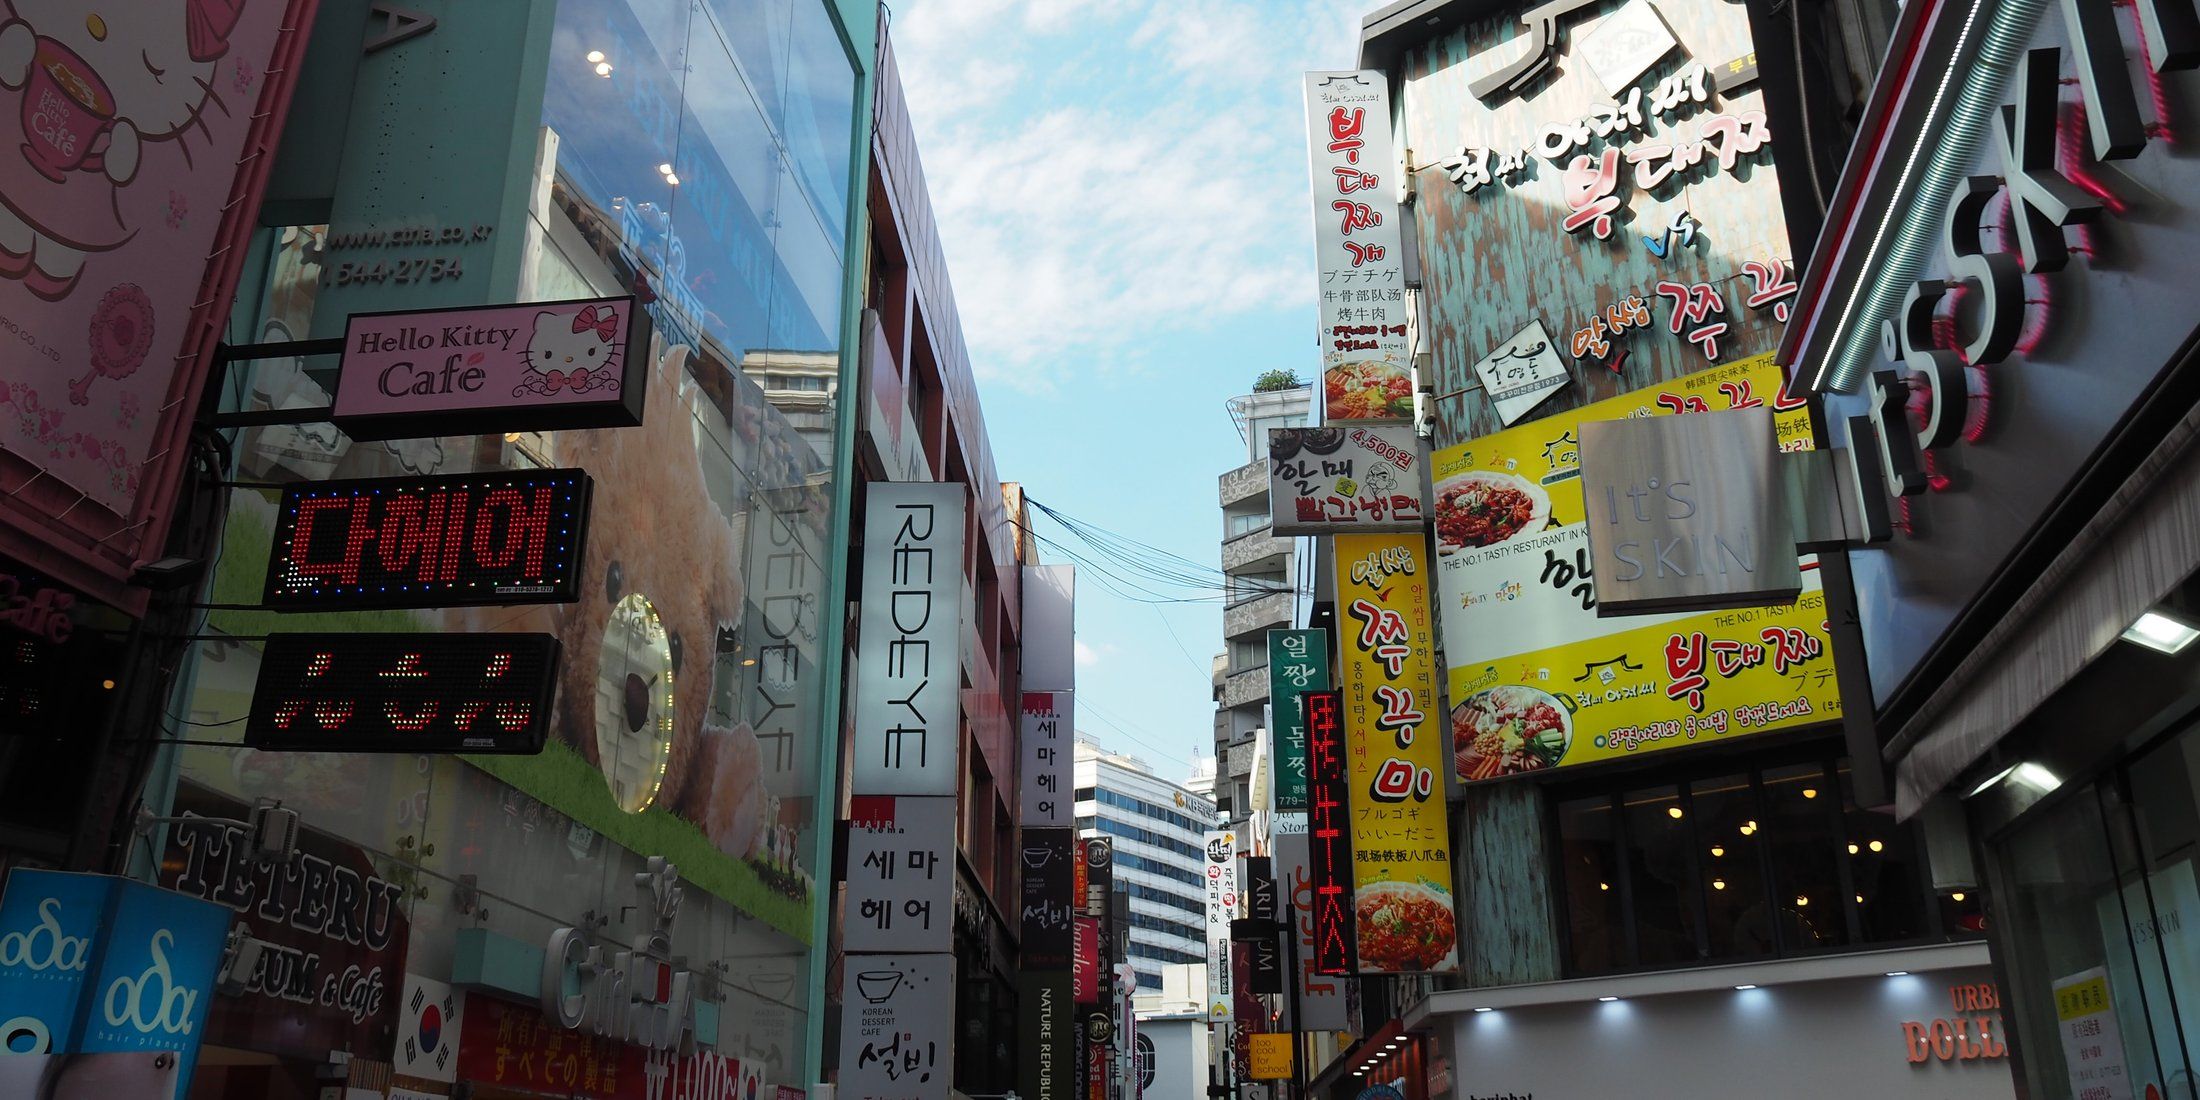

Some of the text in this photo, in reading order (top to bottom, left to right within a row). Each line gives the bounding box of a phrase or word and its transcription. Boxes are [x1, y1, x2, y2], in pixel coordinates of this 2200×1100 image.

[1327, 106, 1386, 267] 부대찌개
[1561, 110, 1773, 241] 부대찌
[1323, 268, 1399, 284] ブデチゲ
[1323, 289, 1401, 303] 牛骨部队汤
[1337, 307, 1386, 322] 烤牛肉
[1656, 257, 1797, 362] 쭈꾸
[357, 325, 518, 354] Hello Kitty
[1776, 417, 1810, 437] 场铁
[1350, 428, 1415, 473] 4,500원
[1295, 495, 1422, 523] 빨간냉면
[1443, 559, 1461, 571] THE
[1462, 555, 1482, 566] NO.1
[1483, 546, 1511, 561] TASTY
[1513, 532, 1567, 554] RESTURANT
[1569, 530, 1579, 540] IN
[1614, 526, 1754, 582] SKIN
[1714, 614, 1735, 628] THE
[1737, 610, 1761, 622] NO.1
[1765, 604, 1796, 618] TASTY
[884, 504, 934, 770] REDEYE
[1664, 620, 1831, 712] 부대찌
[1790, 668, 1834, 692] ブデ
[1608, 718, 1682, 751] 라면사리와
[1684, 706, 1729, 739] 공기밥
[1354, 728, 1368, 773] 서비스
[1279, 796, 1307, 807] 779-
[1357, 807, 1421, 821] ブルゴギ
[851, 820, 895, 829] HAIR
[1279, 821, 1308, 834] Stor
[863, 850, 939, 881] 세마
[1356, 849, 1448, 863] 现场铁板八爪鱼
[177, 809, 403, 951] TETERU
[860, 899, 930, 930] 헤어
[1951, 983, 2000, 1012] URB
[861, 1018, 896, 1026] DESSERT
[1040, 988, 1052, 1040] NATURE
[98, 1031, 187, 1050] hair planet
[861, 1028, 881, 1036] CAFE
[1256, 1039, 1272, 1047] too
[1903, 1016, 2009, 1064] DOLL
[1256, 1046, 1277, 1055] cool
[1256, 1055, 1270, 1064] for
[1256, 1065, 1289, 1075] school
